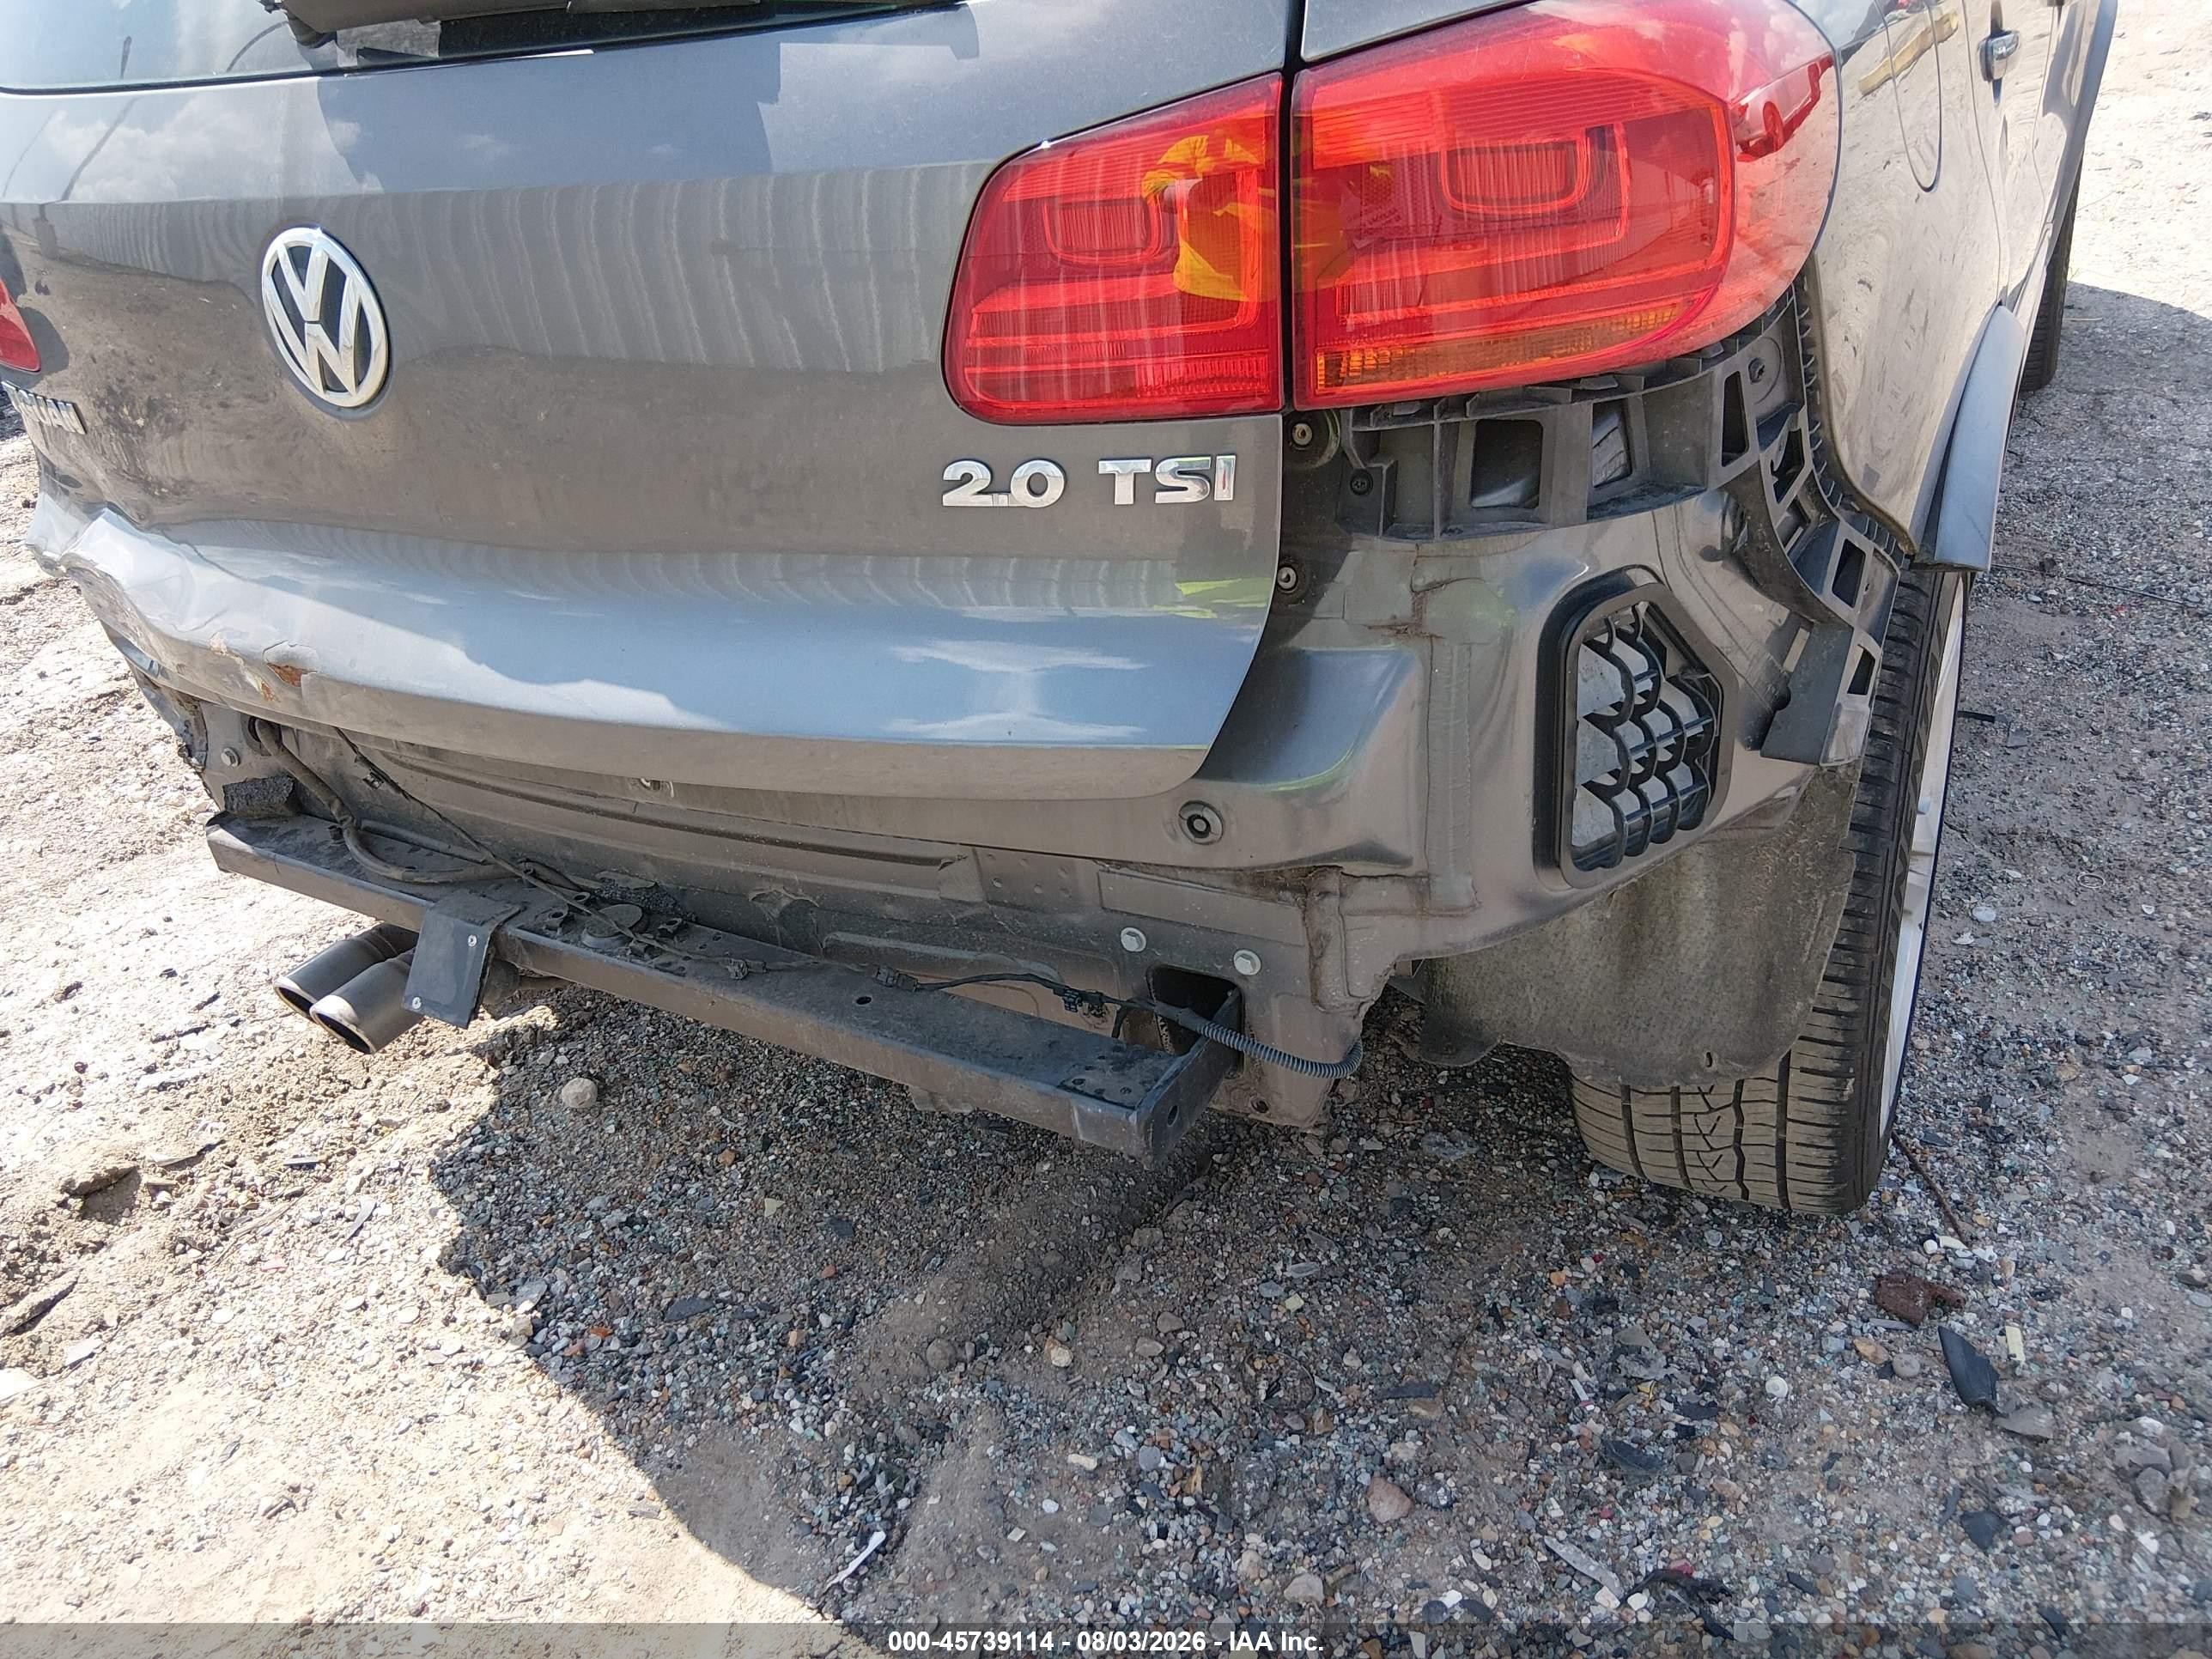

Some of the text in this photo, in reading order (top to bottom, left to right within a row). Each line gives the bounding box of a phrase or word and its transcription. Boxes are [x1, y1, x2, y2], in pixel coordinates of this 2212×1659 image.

[262, 227, 388, 407] VW
[942, 454, 1237, 507] 2.0 TSI
